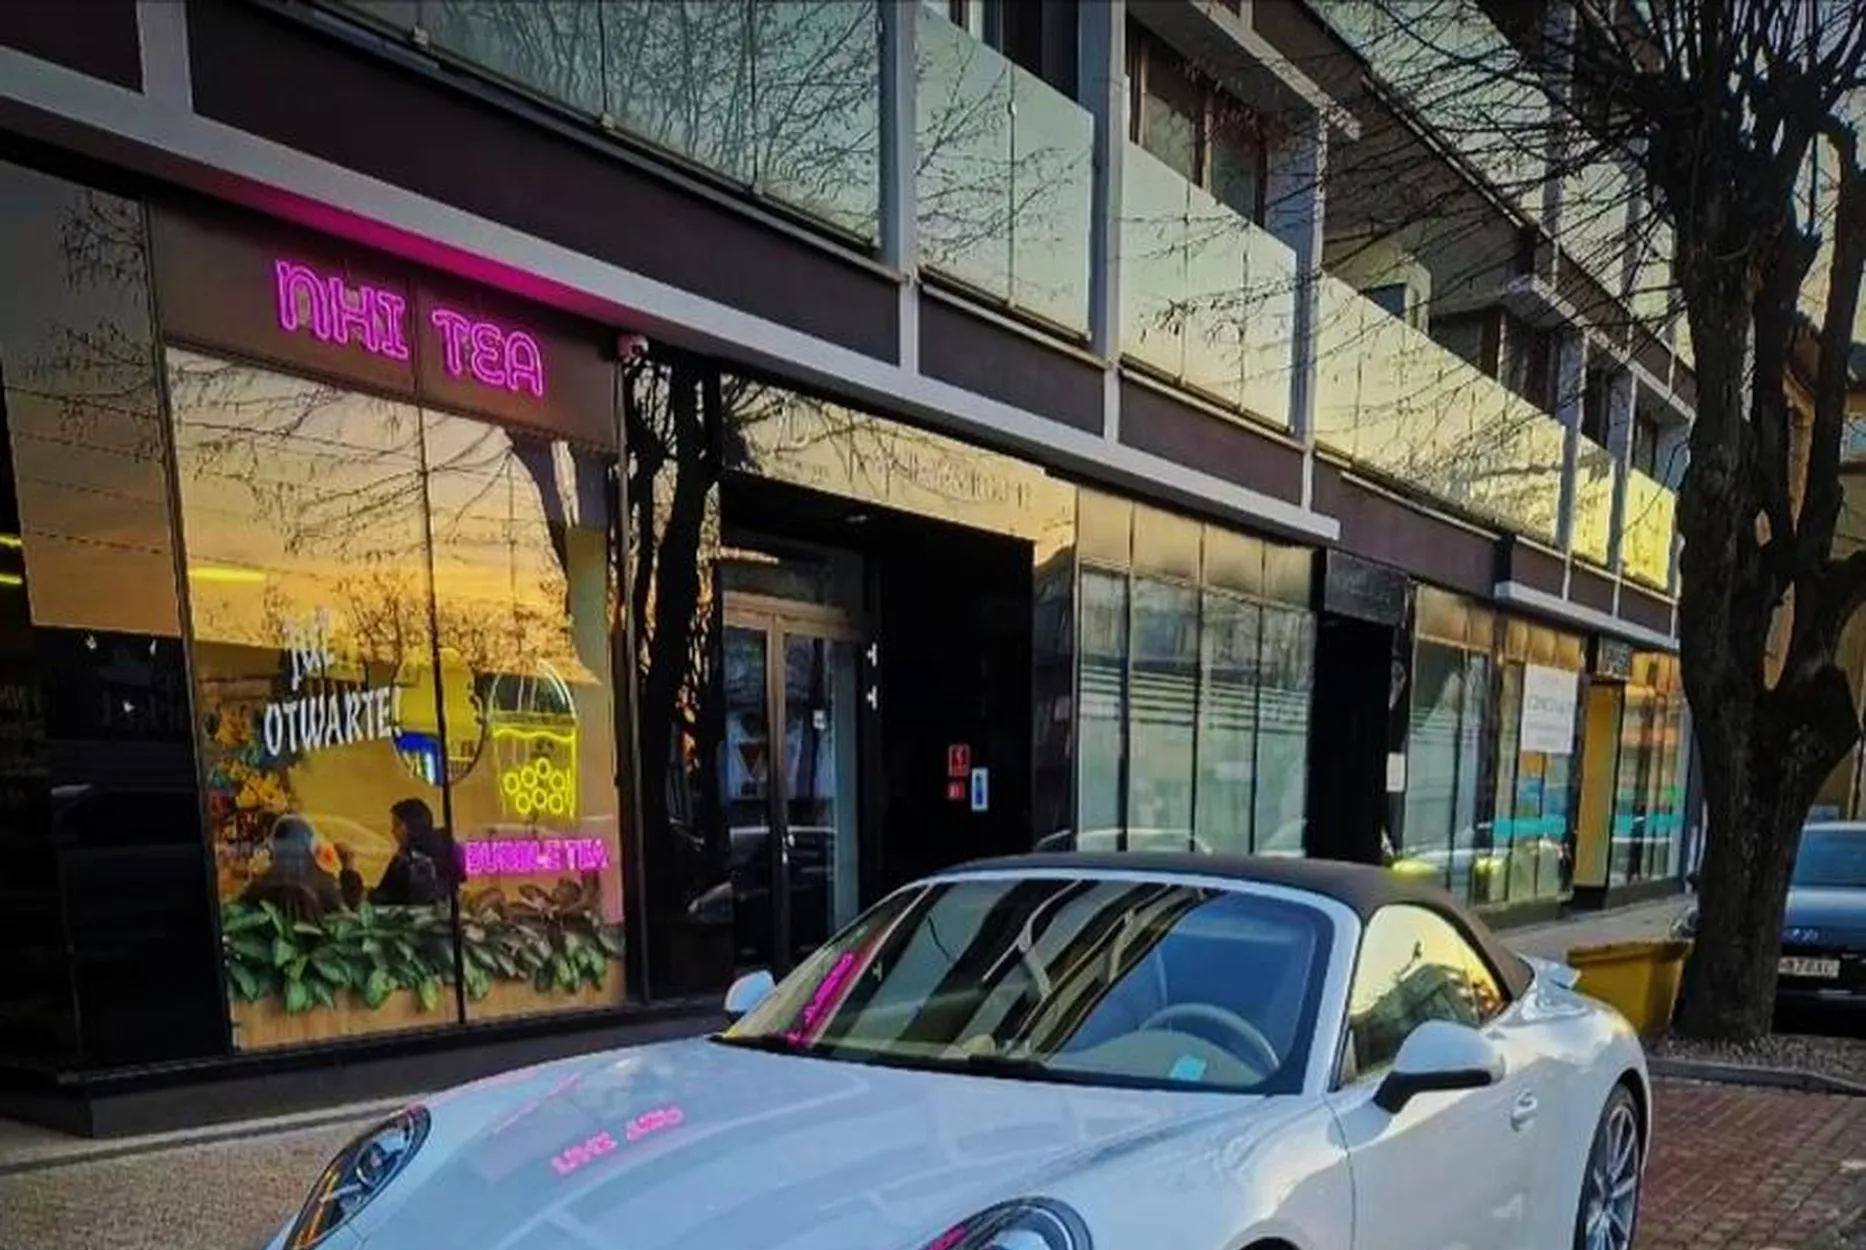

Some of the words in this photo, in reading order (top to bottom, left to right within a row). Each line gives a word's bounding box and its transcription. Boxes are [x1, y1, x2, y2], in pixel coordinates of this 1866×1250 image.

[275, 259, 408, 360] NHI
[432, 308, 543, 397] TEA
[264, 684, 402, 757] OTWARTE!
